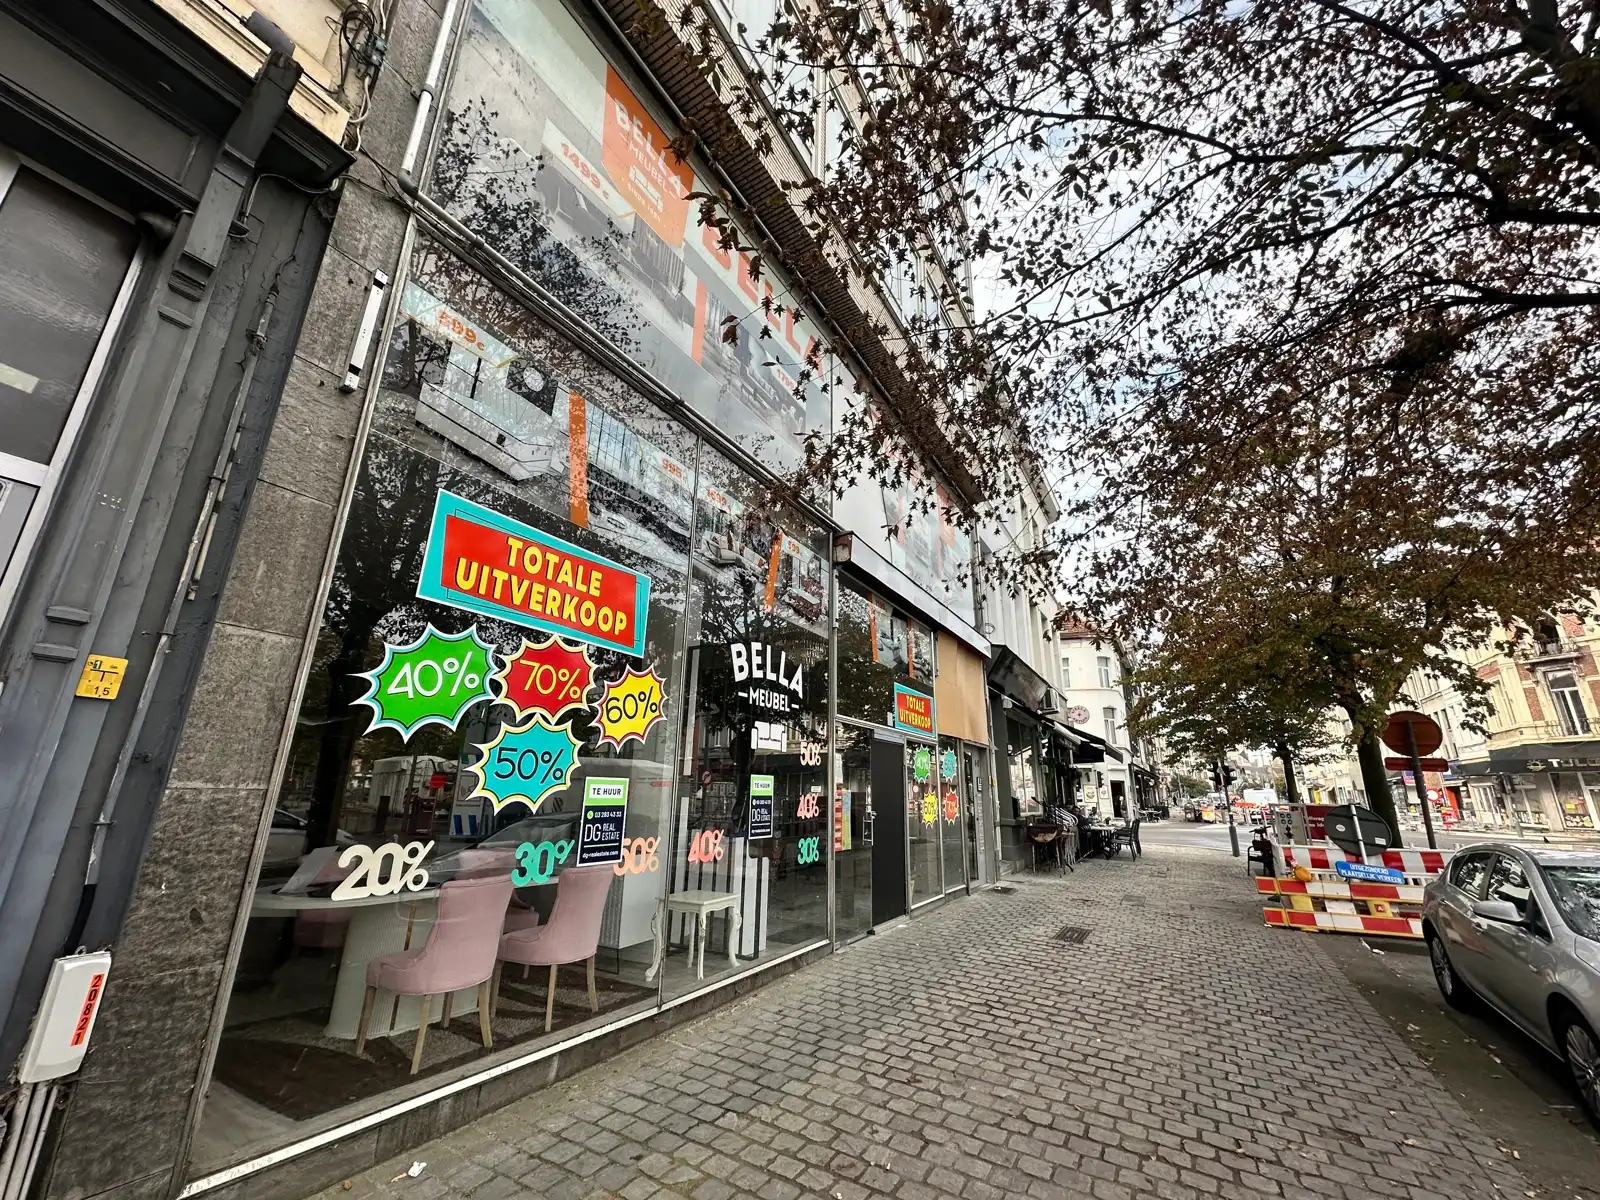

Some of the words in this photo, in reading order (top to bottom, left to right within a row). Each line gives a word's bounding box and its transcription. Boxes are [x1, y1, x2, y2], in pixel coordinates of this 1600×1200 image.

[614, 98, 682, 199] BELLA
[628, 141, 669, 193] MEUBEL
[506, 536, 603, 597] TOTALE
[455, 557, 628, 636] UITVERKOOP
[386, 651, 480, 699] 40%
[519, 659, 582, 700] 70%
[730, 641, 804, 699] BELLA
[605, 686, 658, 724] 60%
[749, 686, 791, 712] MEUBEL
[905, 695, 925, 714] TOTALE
[899, 708, 932, 730] UITVERKOOP
[493, 748, 566, 785] 50%
[800, 741, 822, 767] 50%
[592, 787, 601, 796] TE
[602, 788, 622, 796] HUUR
[796, 792, 820, 820] 40%
[602, 822, 616, 832] REAL
[752, 808, 761, 822] DG
[583, 823, 602, 842] DG
[601, 831, 621, 841] ESTATE
[687, 828, 725, 864] 40%
[511, 838, 576, 888] 30%
[797, 836, 820, 865] 30%
[331, 840, 435, 902] 20%
[1341, 870, 1375, 880] PLAATSELIJK
[1377, 874, 1403, 884] VERKEER
[1349, 864, 1389, 875] UITGEZONDERD
[74, 974, 102, 1046] 20821
